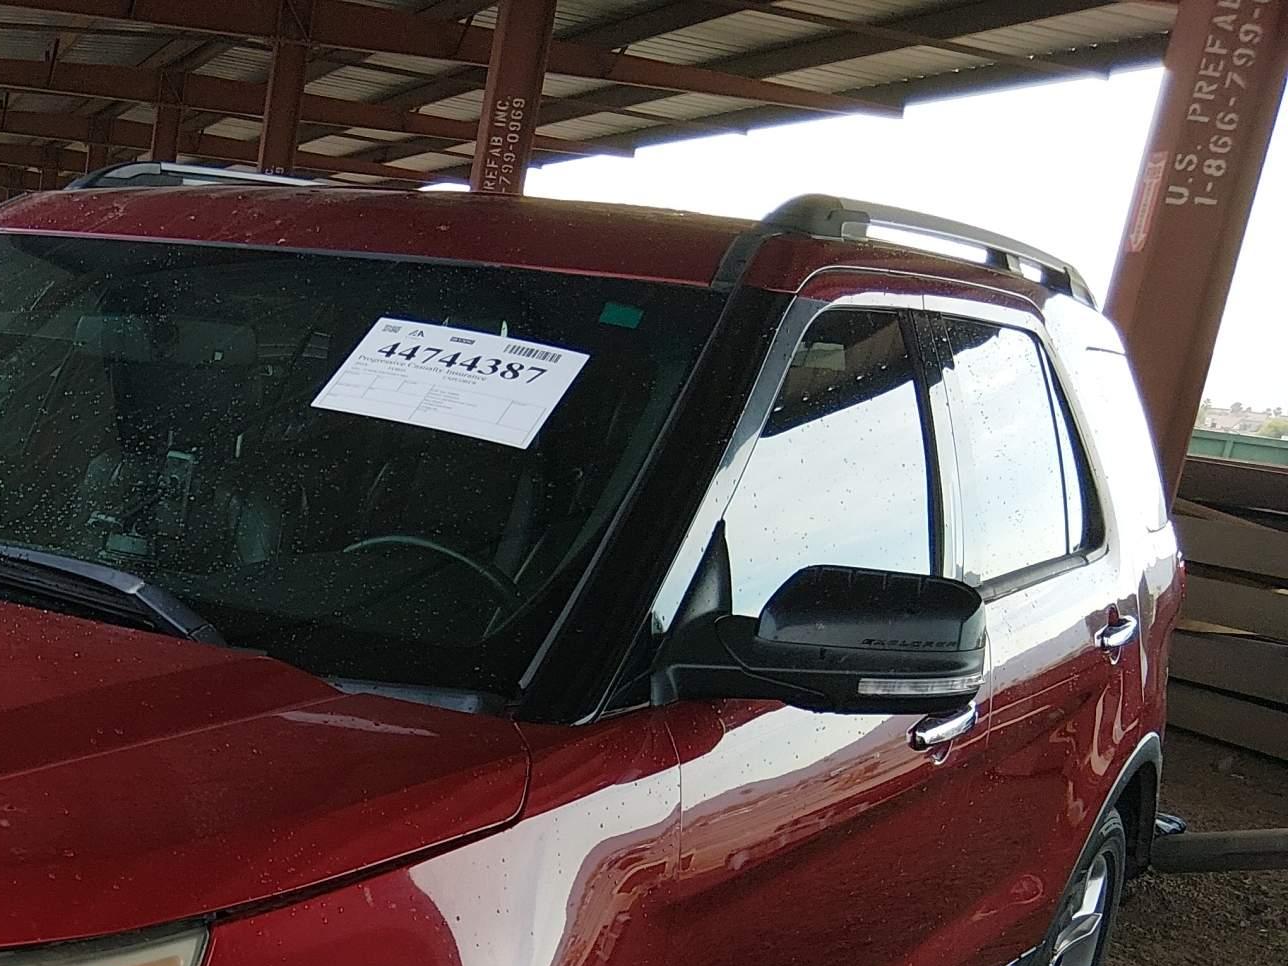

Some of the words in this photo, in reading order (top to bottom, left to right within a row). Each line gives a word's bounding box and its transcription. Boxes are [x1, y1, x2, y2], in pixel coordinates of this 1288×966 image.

[1194, 0, 1269, 206] 1-866-799-
[483, 136, 503, 192] REFAB
[494, 96, 511, 127] INC.
[1165, 143, 1203, 206] U.S.
[358, 354, 407, 367] Progressive
[407, 361, 444, 374] Casualty
[446, 368, 488, 381] Insurance
[377, 342, 548, 384] 44744387
